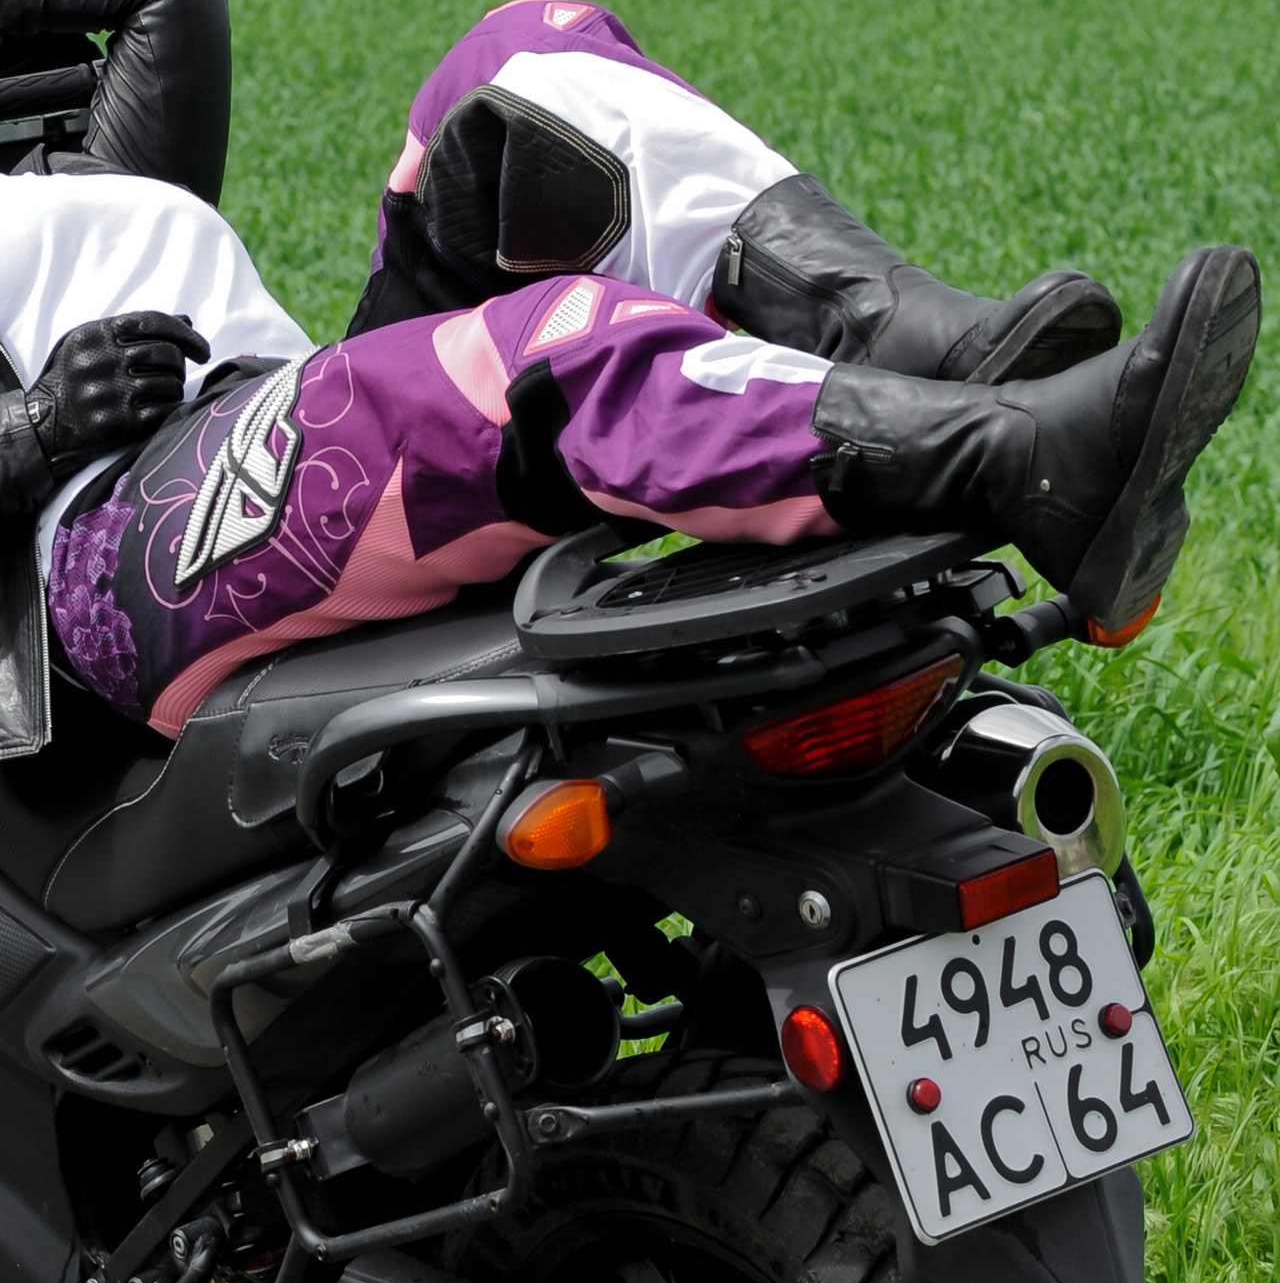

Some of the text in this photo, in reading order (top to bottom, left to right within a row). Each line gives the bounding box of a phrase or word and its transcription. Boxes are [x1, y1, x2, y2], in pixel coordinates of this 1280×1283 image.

[901, 920, 1093, 1061] 4948
[1021, 1019, 1093, 1069] RUS
[931, 1042, 1172, 1218] AC 64
